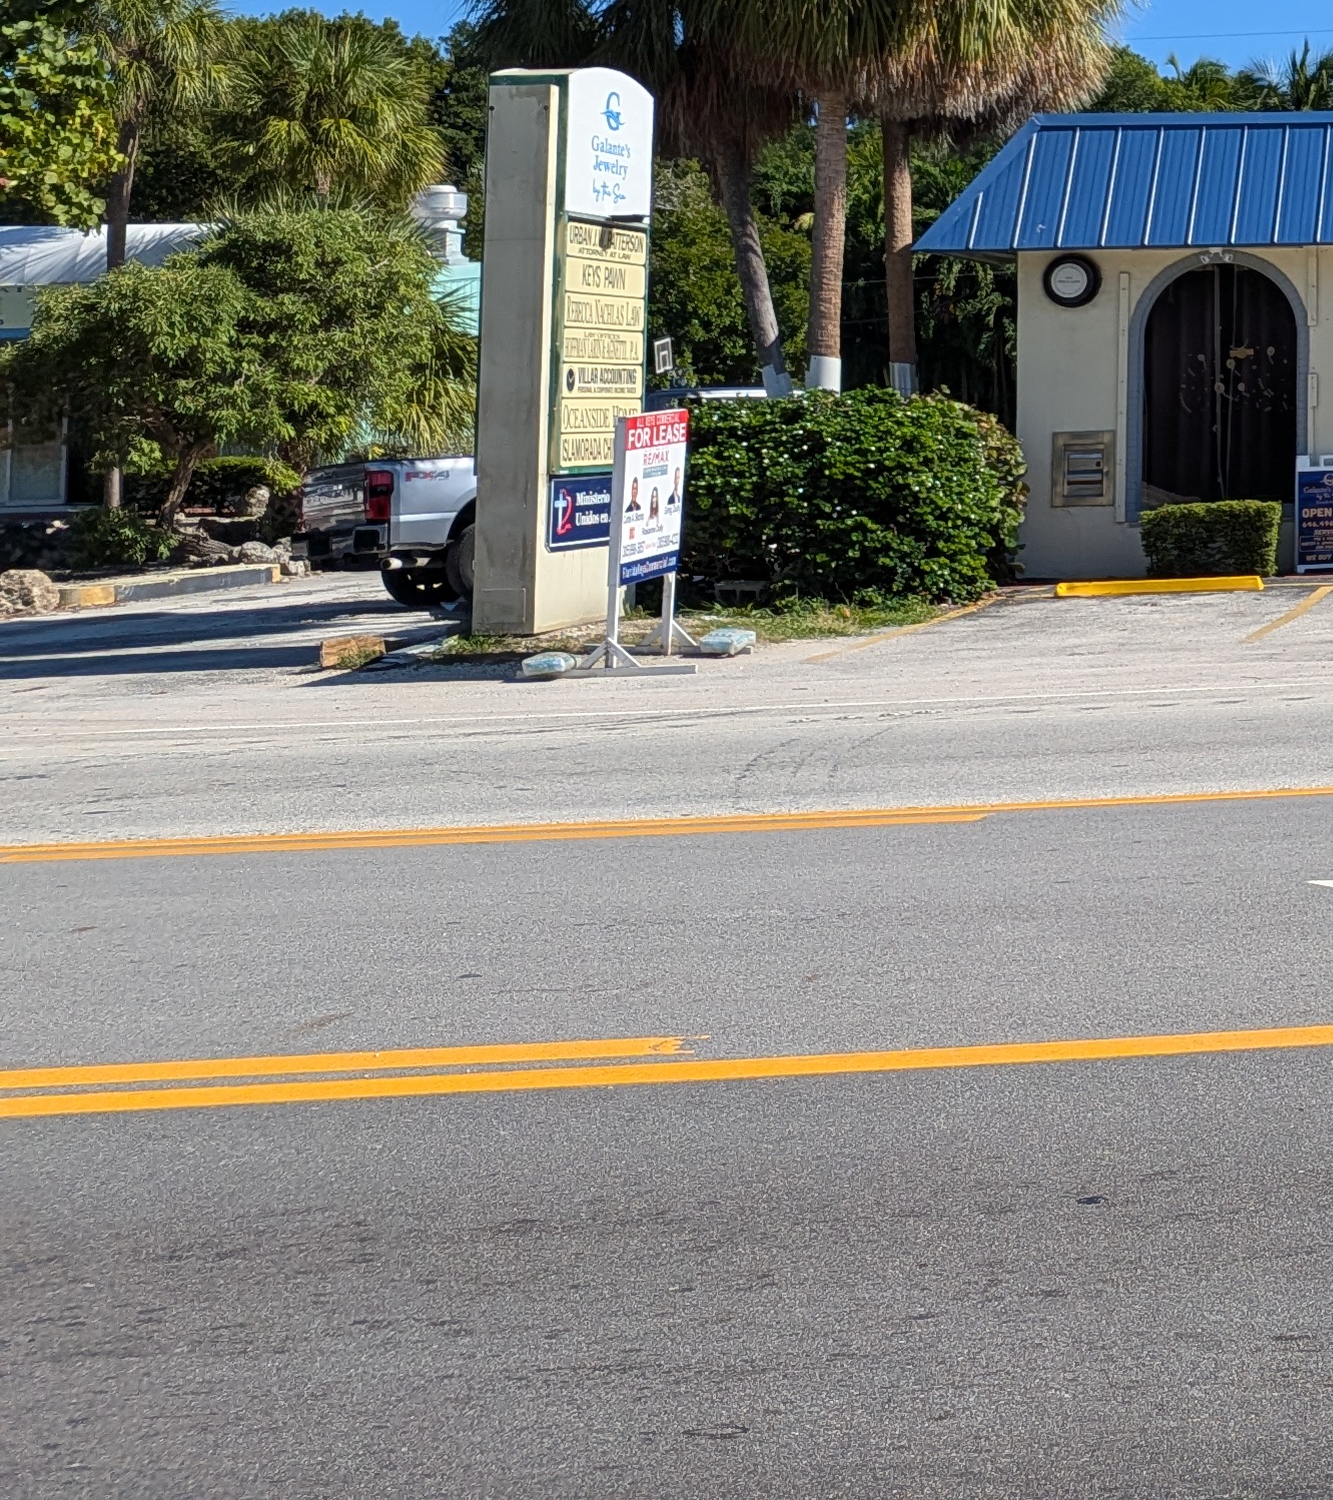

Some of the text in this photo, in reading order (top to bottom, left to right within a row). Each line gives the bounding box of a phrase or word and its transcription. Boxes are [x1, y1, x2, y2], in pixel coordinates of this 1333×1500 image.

[591, 135, 631, 159] Galante's
[593, 155, 628, 180] Jewelry
[569, 225, 593, 246] URBAN
[608, 230, 644, 253] PATTERSON
[578, 247, 608, 257] ATTORNEY
[618, 252, 631, 260] LAW
[582, 263, 626, 290] KEYS PAWN
[626, 302, 641, 326] LAW
[600, 368, 637, 385] ACCOUNTING
[563, 404, 611, 429] OCEANSIDE
[628, 423, 686, 449] FOR LEASE
[562, 438, 602, 462] ISLAMORADA
[643, 450, 669, 466] RE/MAX
[405, 471, 450, 482] FX4
[575, 511, 600, 526] Unidos
[600, 513, 609, 524] en
[1302, 508, 1332, 518] OPEN
